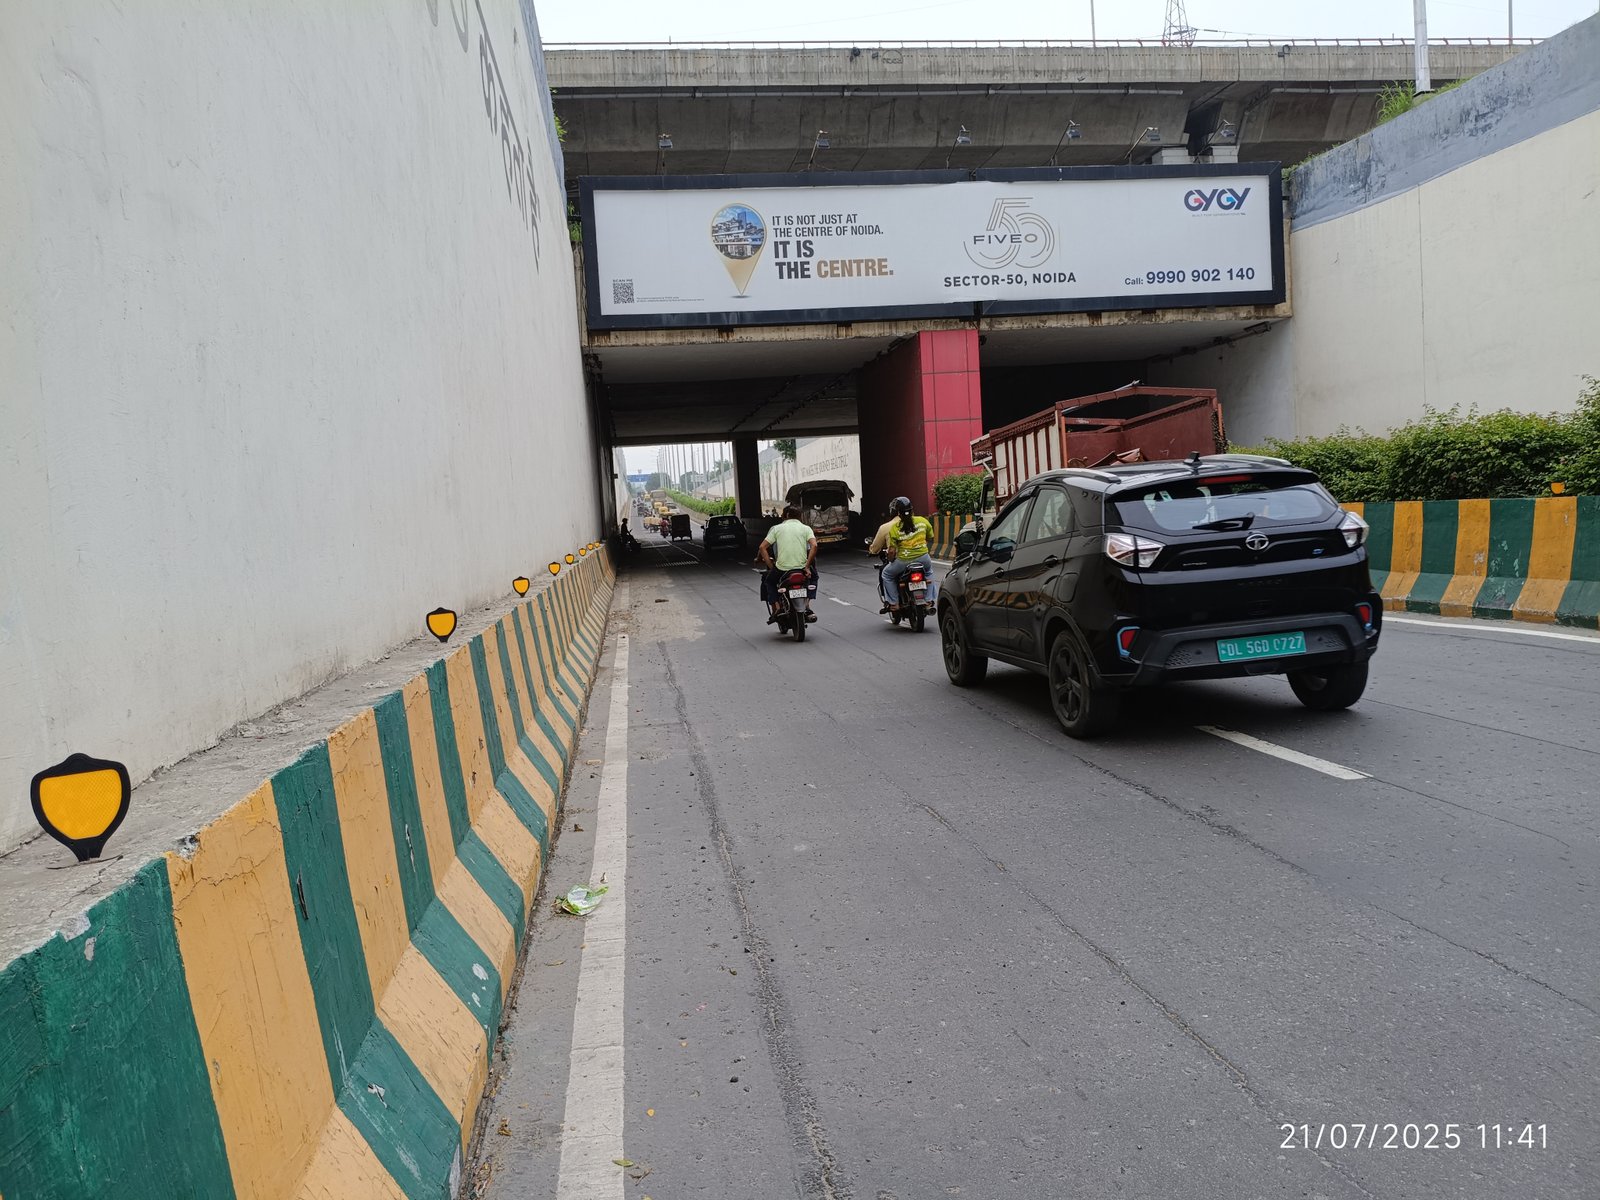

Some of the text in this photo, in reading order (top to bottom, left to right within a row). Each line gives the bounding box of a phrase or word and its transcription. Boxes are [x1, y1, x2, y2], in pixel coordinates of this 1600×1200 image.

[772, 213, 858, 226] IT IS NOT JUST AT
[773, 224, 884, 238] THE CENTRE OF NOIDA.
[774, 239, 815, 259] IT IS
[775, 258, 894, 280] THE CENTRE.
[1125, 267, 1256, 286] Call: 9990 902 140
[944, 272, 1077, 288] SECTOR-50, NOIDA
[1227, 642, 1243, 657] DL
[1246, 639, 1270, 654] 5GD
